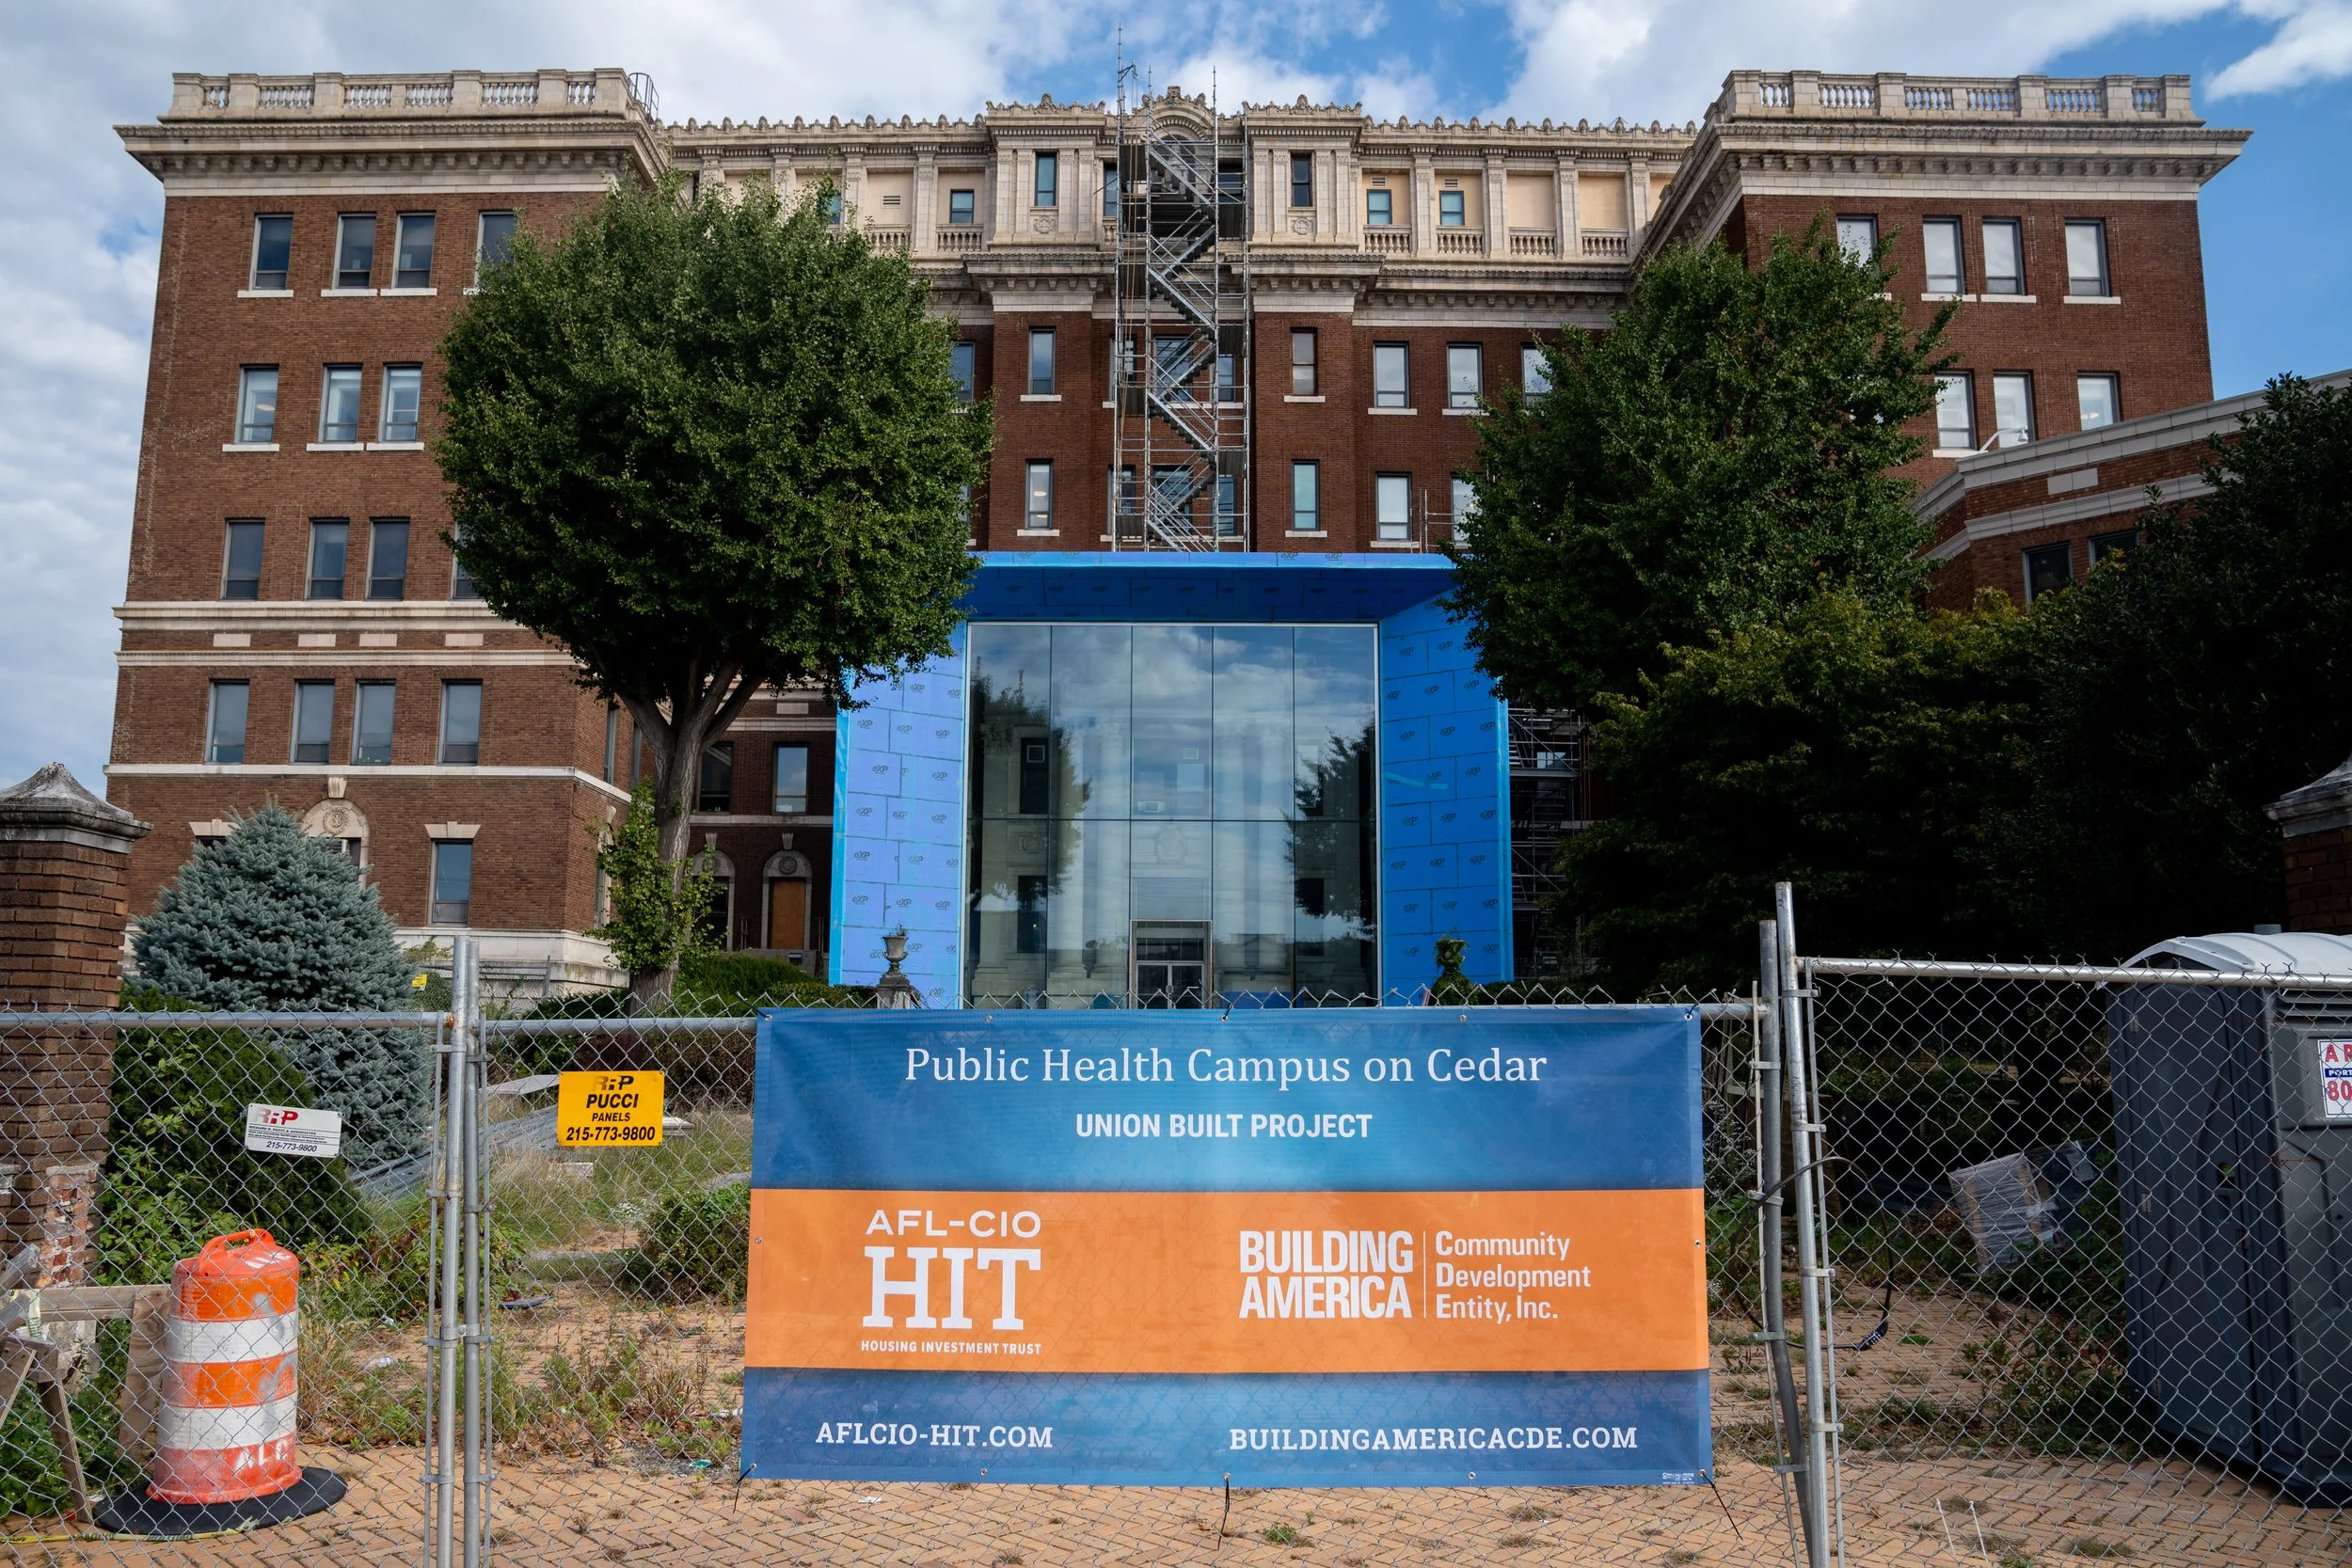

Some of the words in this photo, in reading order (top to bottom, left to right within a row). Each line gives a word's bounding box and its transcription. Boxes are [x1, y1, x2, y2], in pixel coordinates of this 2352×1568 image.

[905, 1047, 1029, 1082] Public
[1042, 1047, 1174, 1082] Health
[1188, 1048, 1350, 1091] Campus
[1363, 1057, 1414, 1082] on
[1427, 1047, 1548, 1082] Cedar
[586, 1093, 639, 1109] PUCCI
[591, 1112, 631, 1122] PANELS
[1076, 1113, 1161, 1138] UNION
[1169, 1114, 1244, 1138] BUILT
[1250, 1114, 1373, 1138] PROJECT
[266, 1141, 318, 1152] 215-773-9800
[566, 1126, 656, 1141] 215-773-9800
[866, 1209, 1041, 1239] AFL-CIO
[1239, 1229, 1414, 1275] BUILDING
[1435, 1230, 1570, 1261] Community
[862, 1245, 1041, 1331] HIT
[1436, 1262, 1591, 1292] Development
[1238, 1275, 1413, 1320] AMERICA
[1436, 1293, 1512, 1324] Entity,
[1517, 1295, 1559, 1320] Inc.
[861, 1339, 917, 1354] HOUSING
[921, 1341, 1000, 1355] INVESTMENT
[1002, 1342, 1041, 1355] TRUST
[815, 1422, 1054, 1449] AFLCIO-HIT.COM
[1230, 1427, 1638, 1450] BUILDINGAMERICACDE.COM
